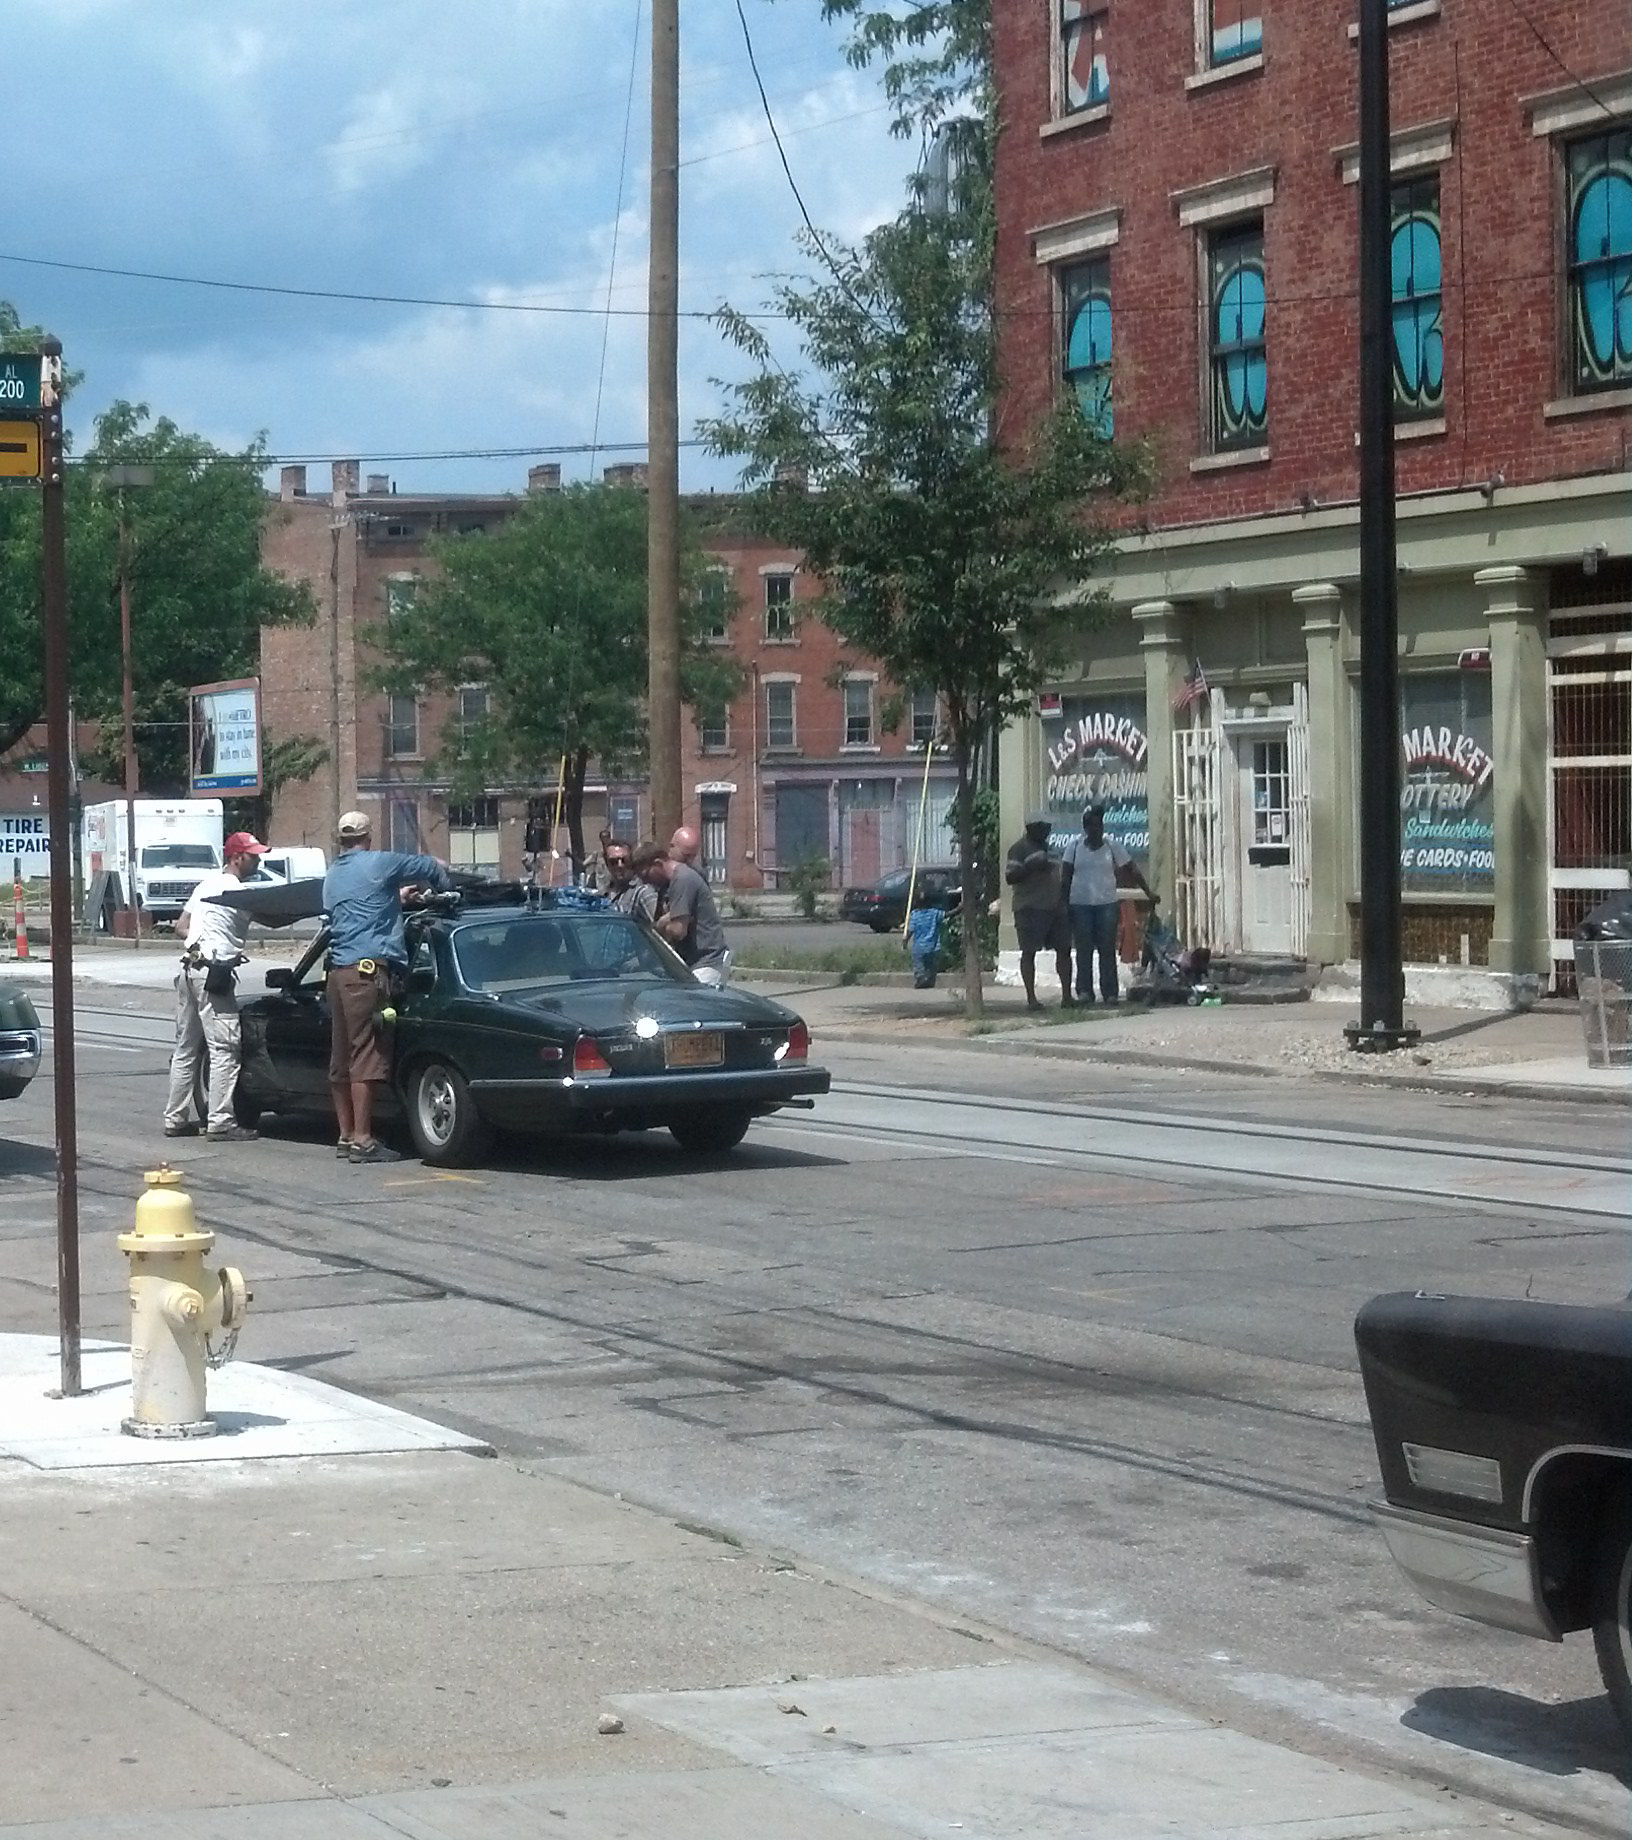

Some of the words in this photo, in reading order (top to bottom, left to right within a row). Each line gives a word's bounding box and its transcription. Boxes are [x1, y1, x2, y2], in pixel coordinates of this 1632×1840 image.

[5, 364, 17, 379] AL
[1049, 728, 1077, 770] L&S
[1079, 713, 1148, 762] MARKET
[1402, 725, 1493, 785] MARKET
[1047, 774, 1095, 801] CHECK
[1401, 783, 1474, 810] OTTERY
[3, 818, 44, 834] TIRE
[1405, 815, 1494, 839] Sandwiches
[1416, 848, 1465, 868] CARDS
[1468, 849, 1494, 869] FOO
